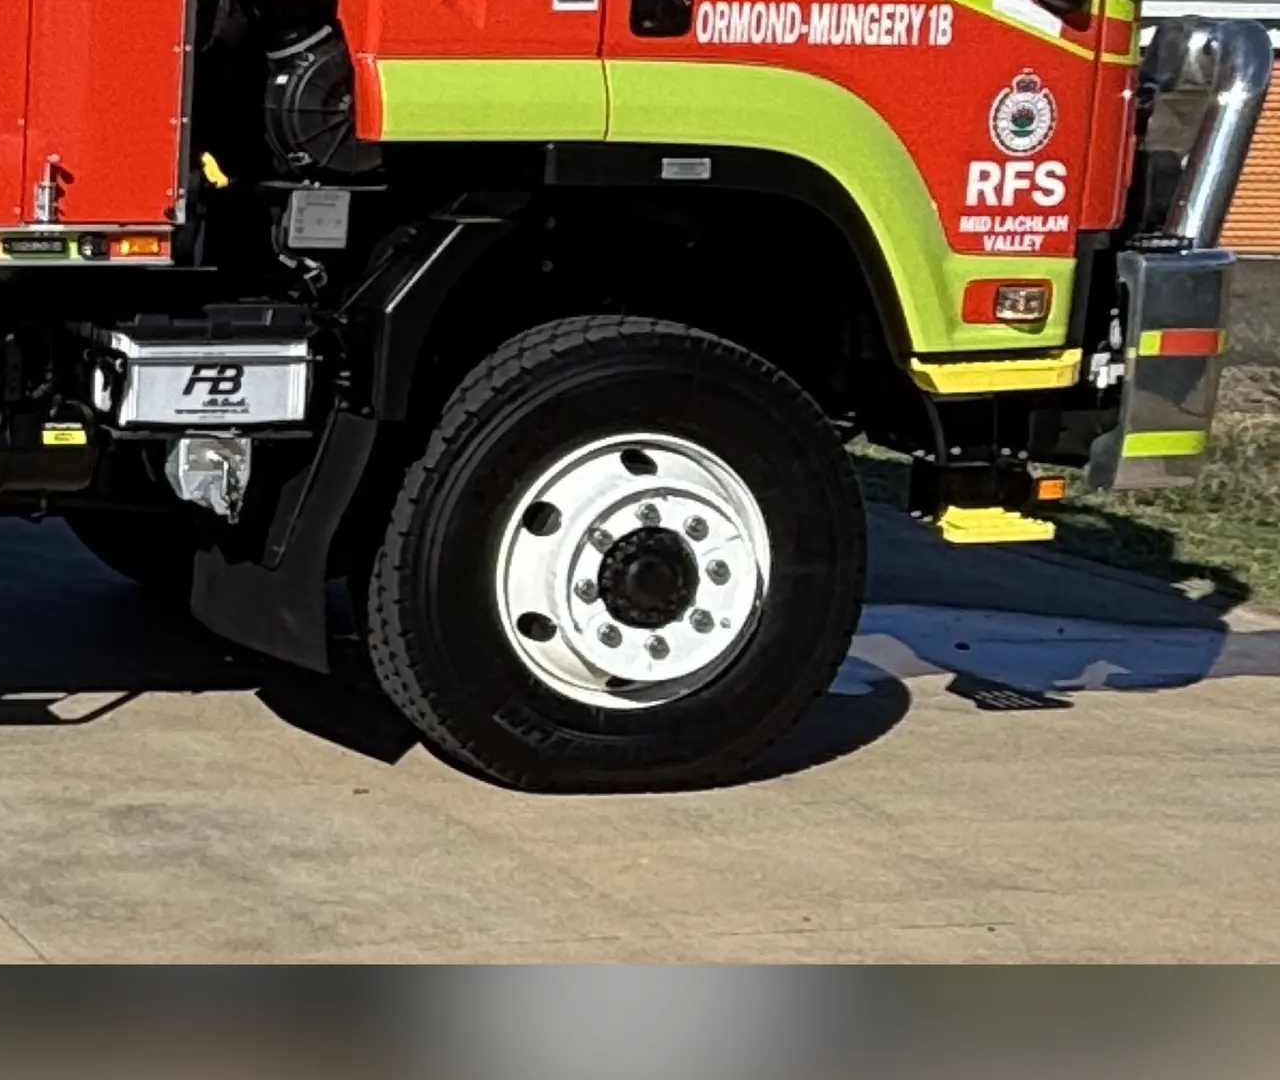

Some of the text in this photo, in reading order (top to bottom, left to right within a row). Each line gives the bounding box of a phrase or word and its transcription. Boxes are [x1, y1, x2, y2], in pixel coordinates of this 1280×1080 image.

[695, 1, 953, 46] ORMOND-MUNGERY 1B
[966, 160, 1067, 207] RFS
[960, 215, 1069, 233] MID LACHLAN
[982, 234, 1045, 253] VALLEY
